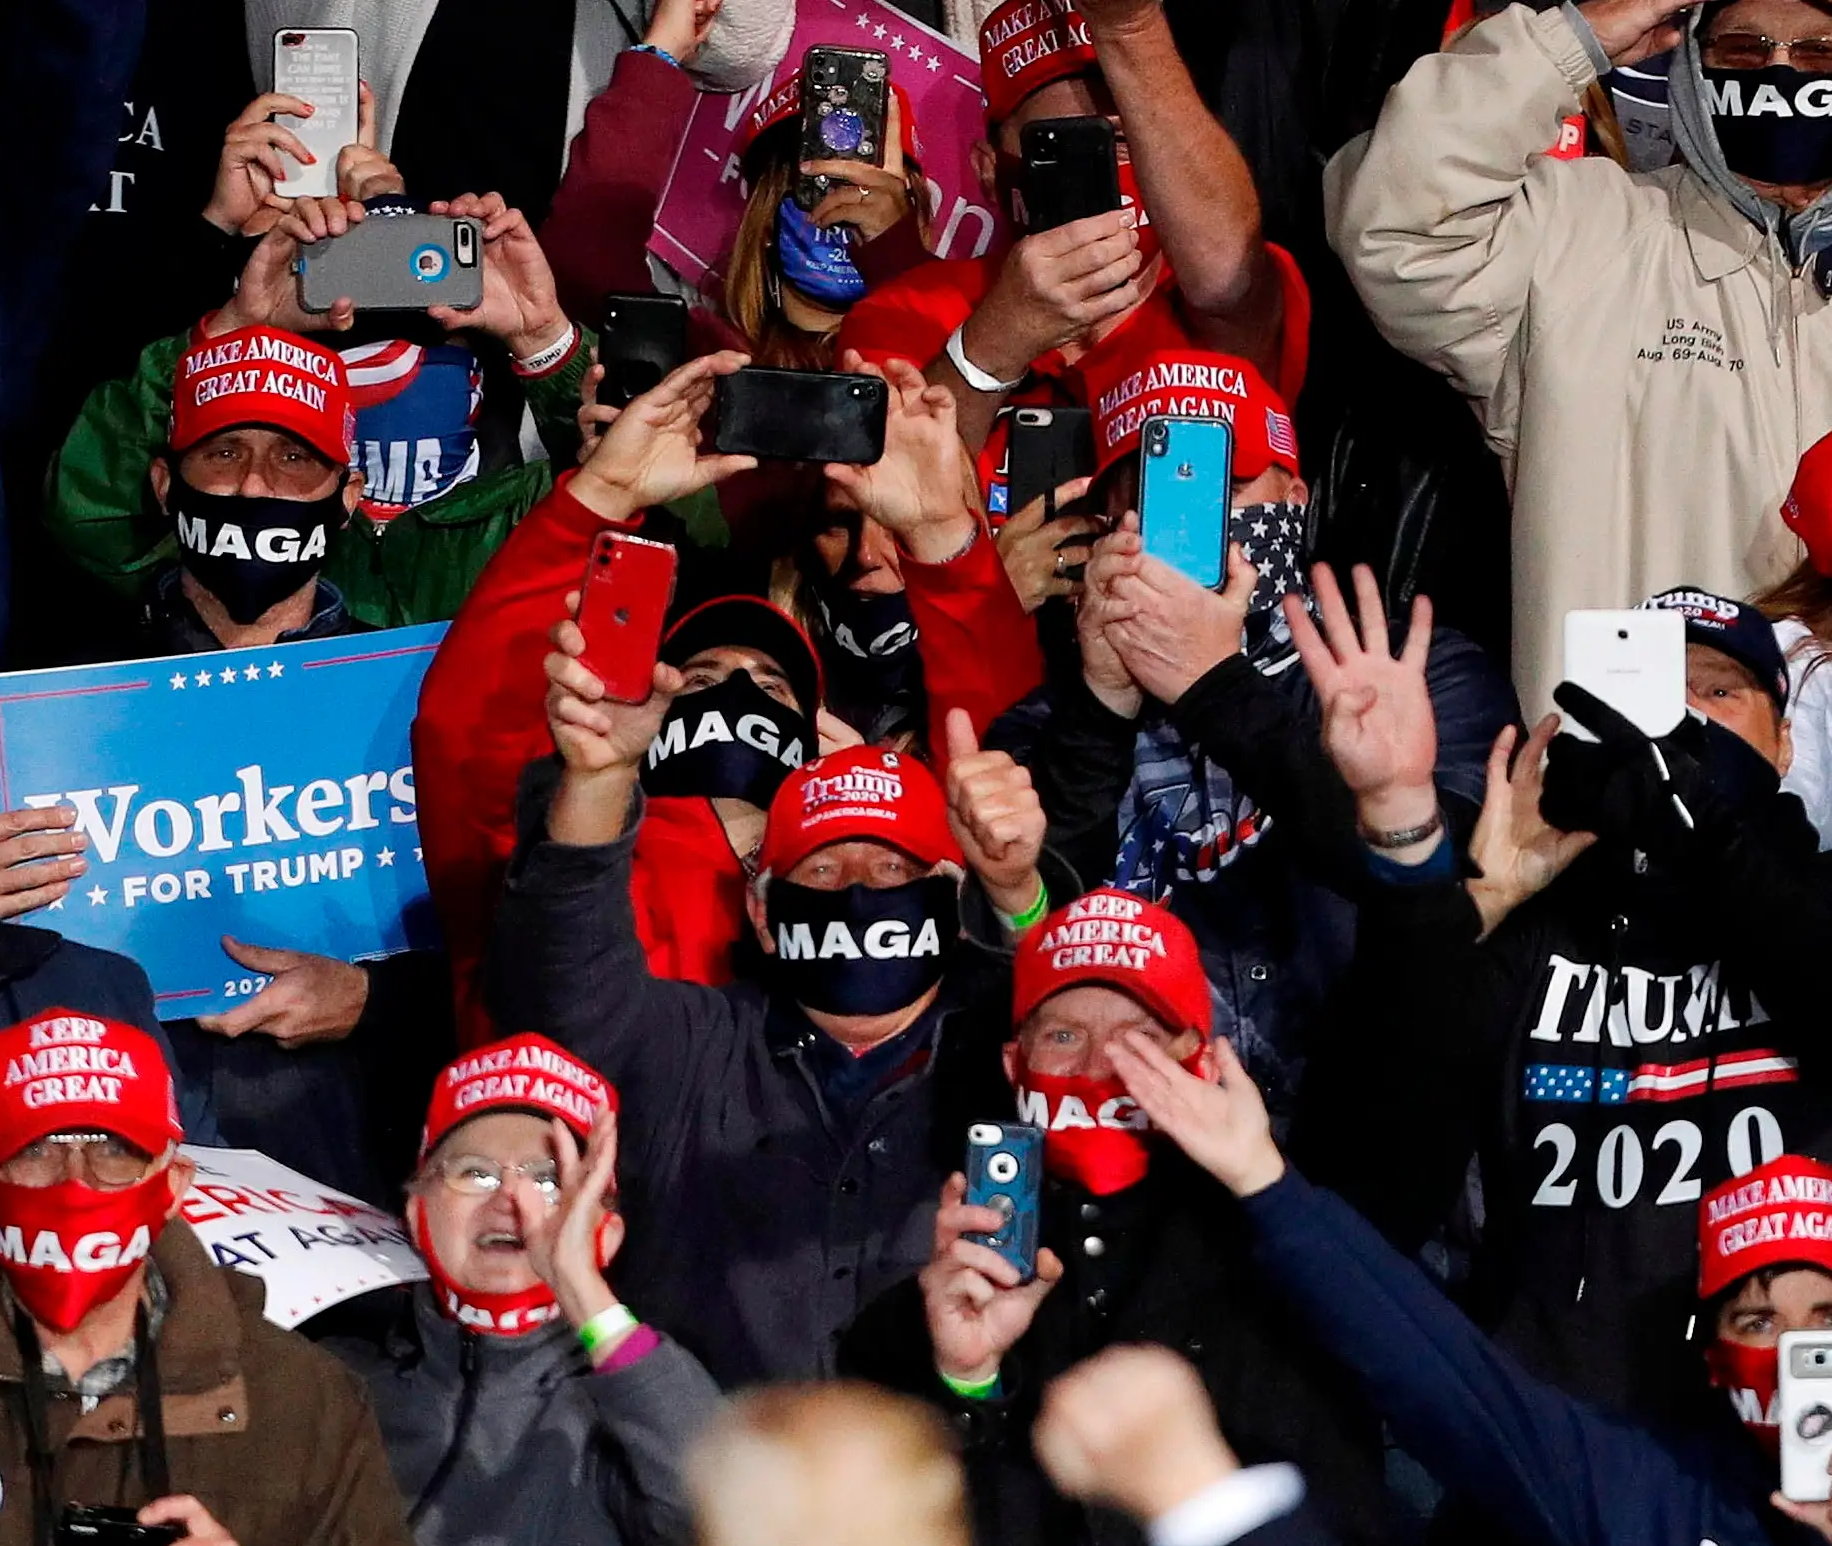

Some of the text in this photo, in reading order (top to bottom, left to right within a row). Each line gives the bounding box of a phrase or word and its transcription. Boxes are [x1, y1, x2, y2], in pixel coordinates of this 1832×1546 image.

[1003, 28, 1060, 77] GREAT
[1663, 335, 1696, 347] Long
[1667, 319, 1723, 342] US Army
[185, 335, 338, 386] MAKE AMERICA
[1729, 359, 1745, 371] 70
[195, 370, 326, 413] GREAT AGAIN
[1099, 363, 1247, 420] MAKE AMERICA
[178, 510, 326, 563] MAGA
[648, 710, 803, 771] MAGA
[800, 771, 903, 804] Trump
[842, 791, 880, 804] 2020
[23, 764, 417, 863] Workers
[123, 847, 363, 908] FOR TRUMP
[1066, 894, 1143, 921] KEEP
[778, 918, 940, 960] MAGA
[1038, 920, 1166, 957] AMERICA
[1052, 944, 1151, 972] GREAT
[1530, 953, 1771, 1047] TRUM
[29, 1017, 107, 1049] KEEP
[4, 1048, 139, 1087] AMERICA
[447, 1046, 609, 1103] MAKE AMERICA
[23, 1074, 123, 1109] GREAT
[455, 1074, 598, 1127] GREAT AGAIN
[1016, 1085, 1156, 1131] MAG
[1532, 1107, 1785, 1209] 2020
[180, 1184, 389, 1225] ERICA
[1708, 1180, 1765, 1226] MAKE
[1719, 1212, 1789, 1257] GREAT
